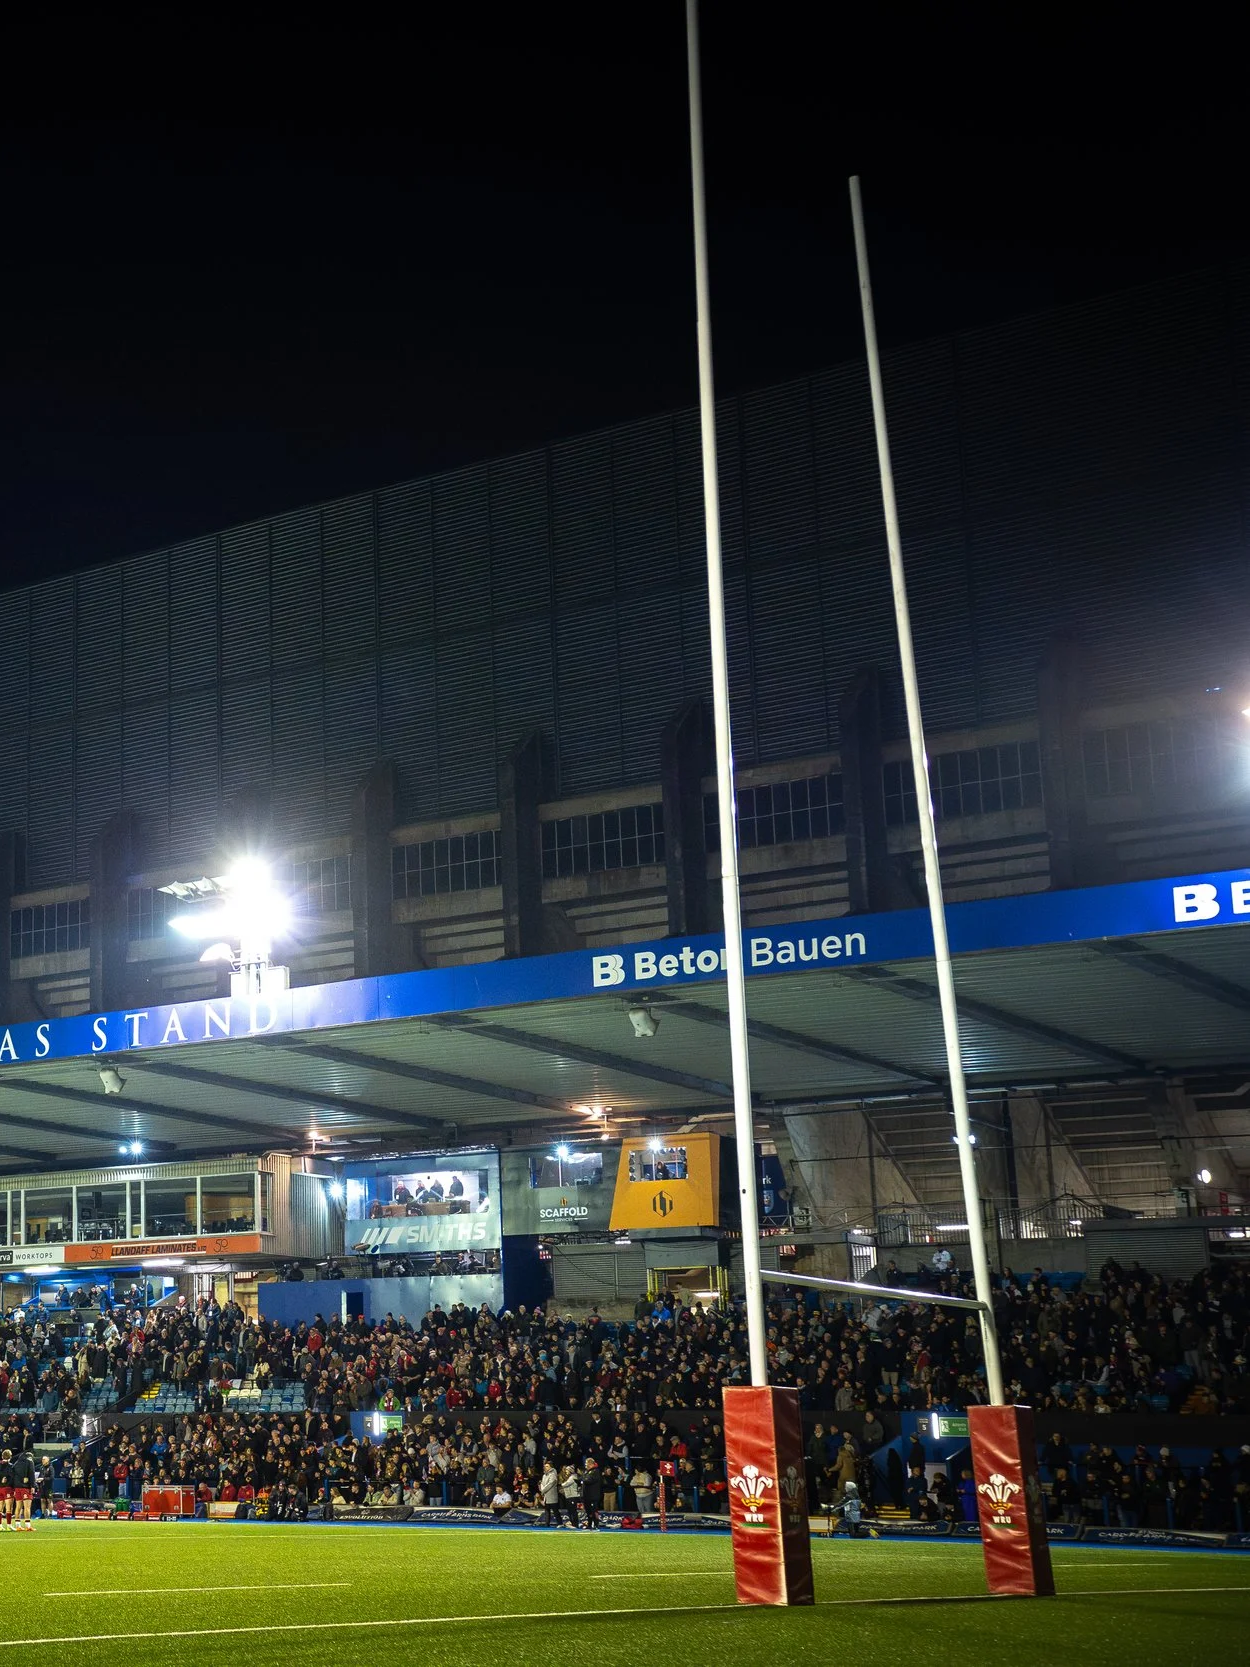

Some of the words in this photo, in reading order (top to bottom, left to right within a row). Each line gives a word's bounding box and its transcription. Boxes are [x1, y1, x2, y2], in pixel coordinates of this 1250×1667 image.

[751, 932, 867, 967] Bauen
[92, 999, 278, 1051] STAND
[540, 1206, 588, 1218] SCAFFOLD
[406, 1221, 487, 1244] SMITHS
[111, 1246, 150, 1256] LLANDAFF
[151, 1243, 197, 1254] LAMINATES
[15, 1252, 53, 1260] WORKTOPS
[744, 1513, 764, 1523] WRU
[992, 1515, 1012, 1524] WRU
